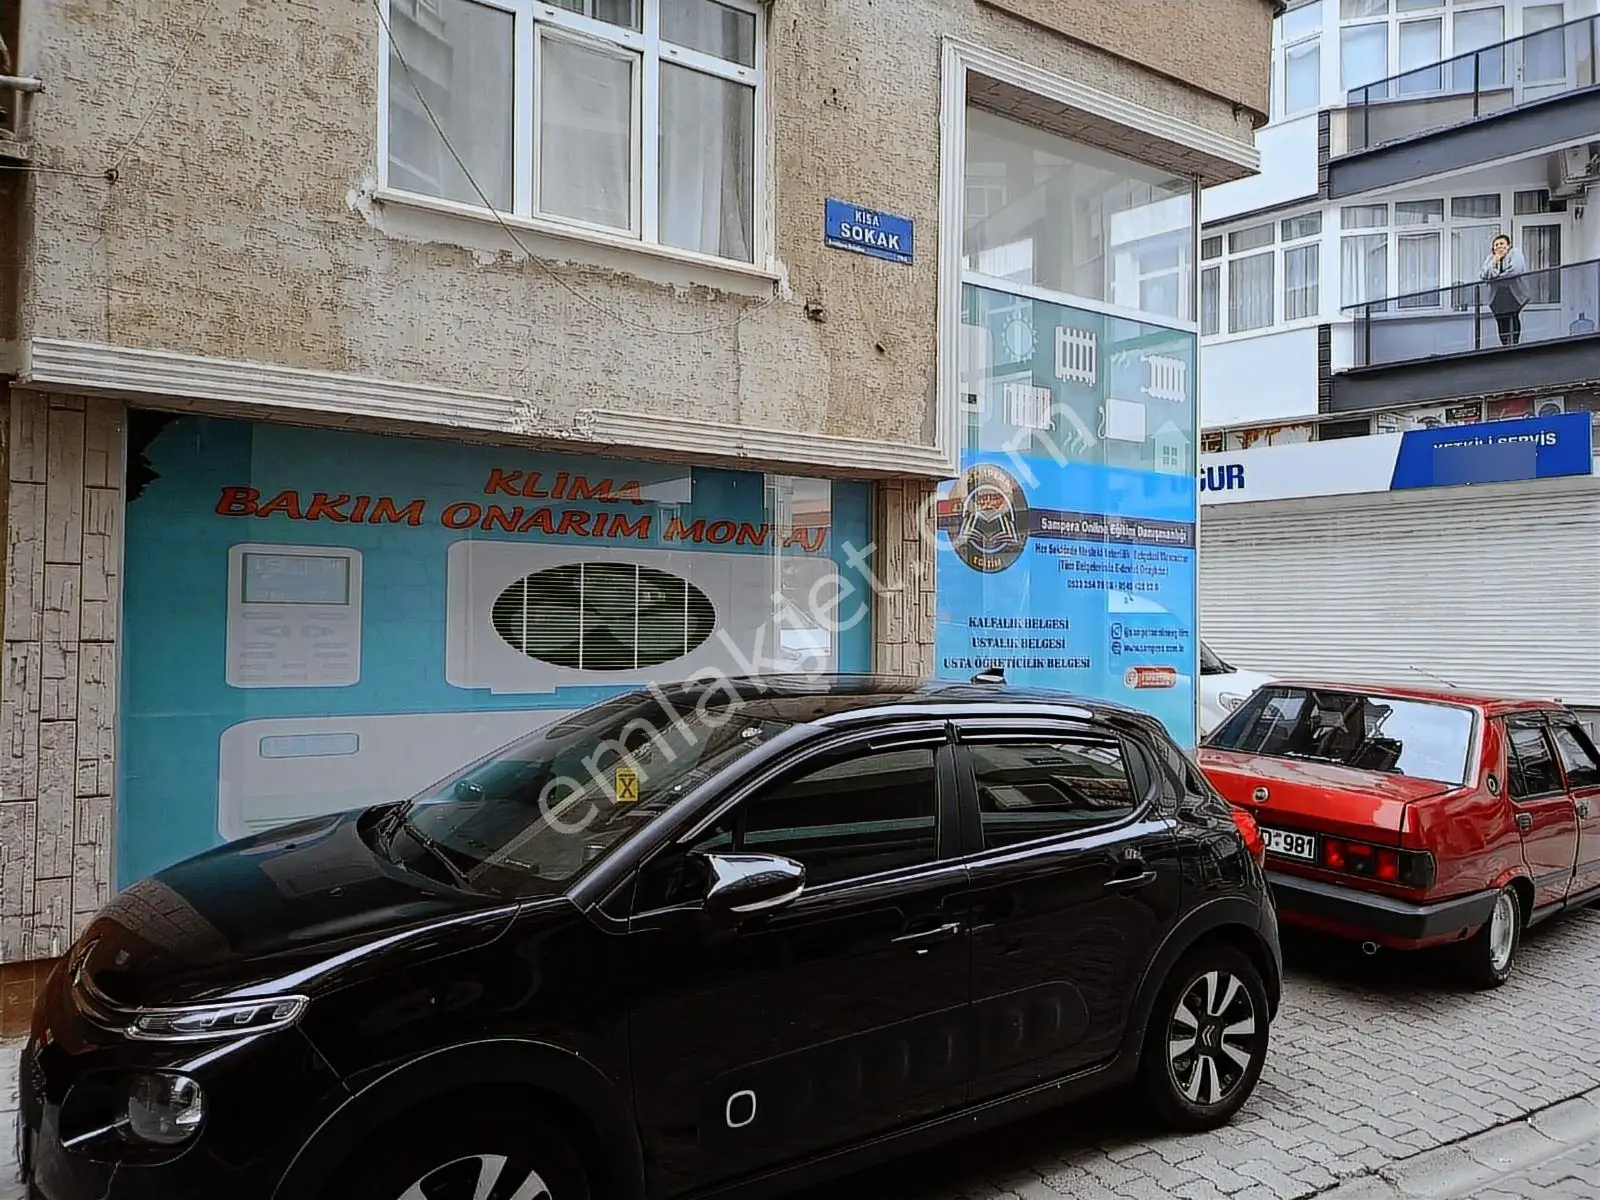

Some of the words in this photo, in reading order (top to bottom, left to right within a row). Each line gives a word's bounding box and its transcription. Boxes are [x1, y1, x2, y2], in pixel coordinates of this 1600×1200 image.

[841, 222, 900, 250] SOKAK
[483, 467, 645, 506] KLİMA
[214, 486, 426, 527] BAKIM
[440, 501, 653, 540] ONARIM
[662, 516, 827, 553] MONTAJ
[1041, 516, 1080, 534] Sampera
[1081, 520, 1109, 534] Online
[1110, 523, 1136, 538] Eğitim
[968, 616, 1023, 630] KALFALIK
[1024, 615, 1069, 630] BELGESİ
[972, 636, 1020, 649] USTALIK
[1021, 635, 1066, 649] BELGESİ
[944, 656, 973, 669] USTA
[1045, 655, 1091, 669] BELGESİ
[1283, 834, 1313, 857] 981
